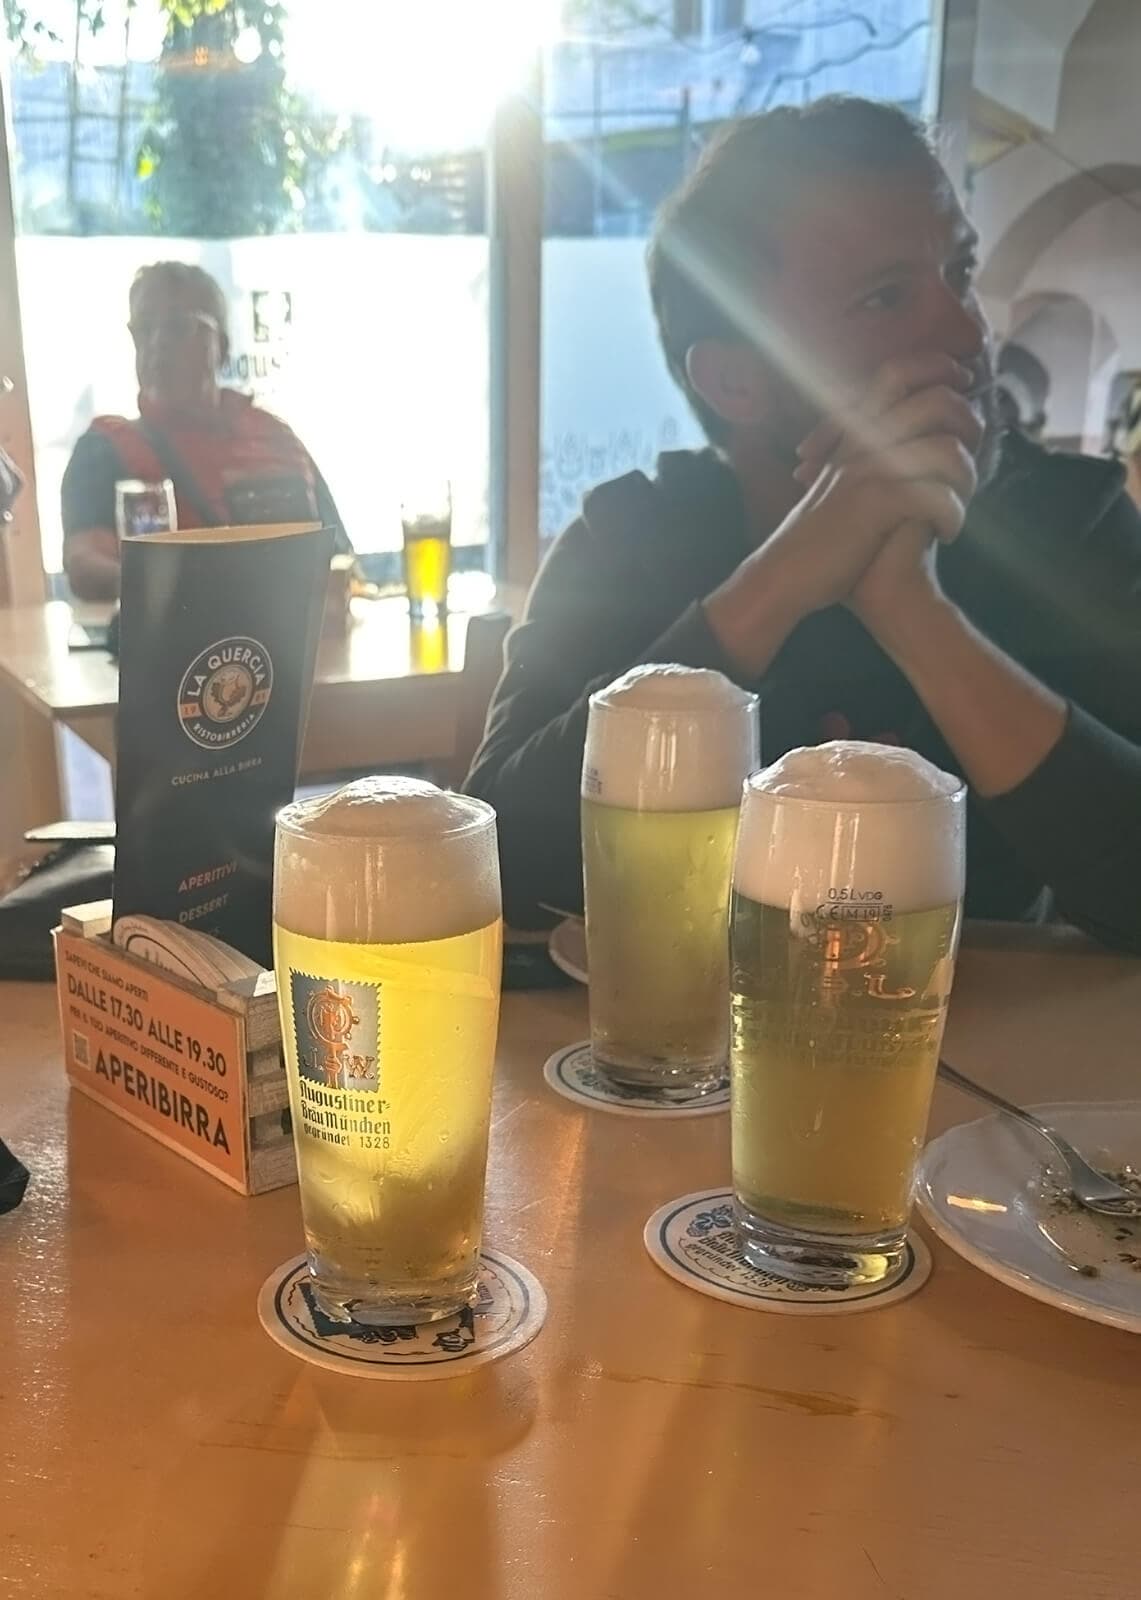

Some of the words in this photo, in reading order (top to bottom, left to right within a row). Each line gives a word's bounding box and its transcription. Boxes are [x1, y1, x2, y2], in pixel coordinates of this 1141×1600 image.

[187, 675, 207, 697] LA
[207, 647, 266, 686] QUERCIA
[171, 771, 210, 786] CUCINA
[213, 765, 236, 778] ALLA
[178, 860, 239, 894] APERITIVI
[179, 893, 230, 923] DESSERT
[125, 982, 149, 1002] APERTI
[67, 972, 108, 1013] DALLE
[109, 995, 144, 1032] 17.30
[148, 1017, 184, 1055] ALLE
[187, 1036, 227, 1078] 19.30
[140, 1043, 180, 1076] DIFFERENTE
[188, 1071, 229, 1104] GUSTOSO?
[95, 1047, 231, 1157] APERIBIRRA
[304, 1122, 351, 1147] gegründet
[360, 1136, 390, 1150] 1328
